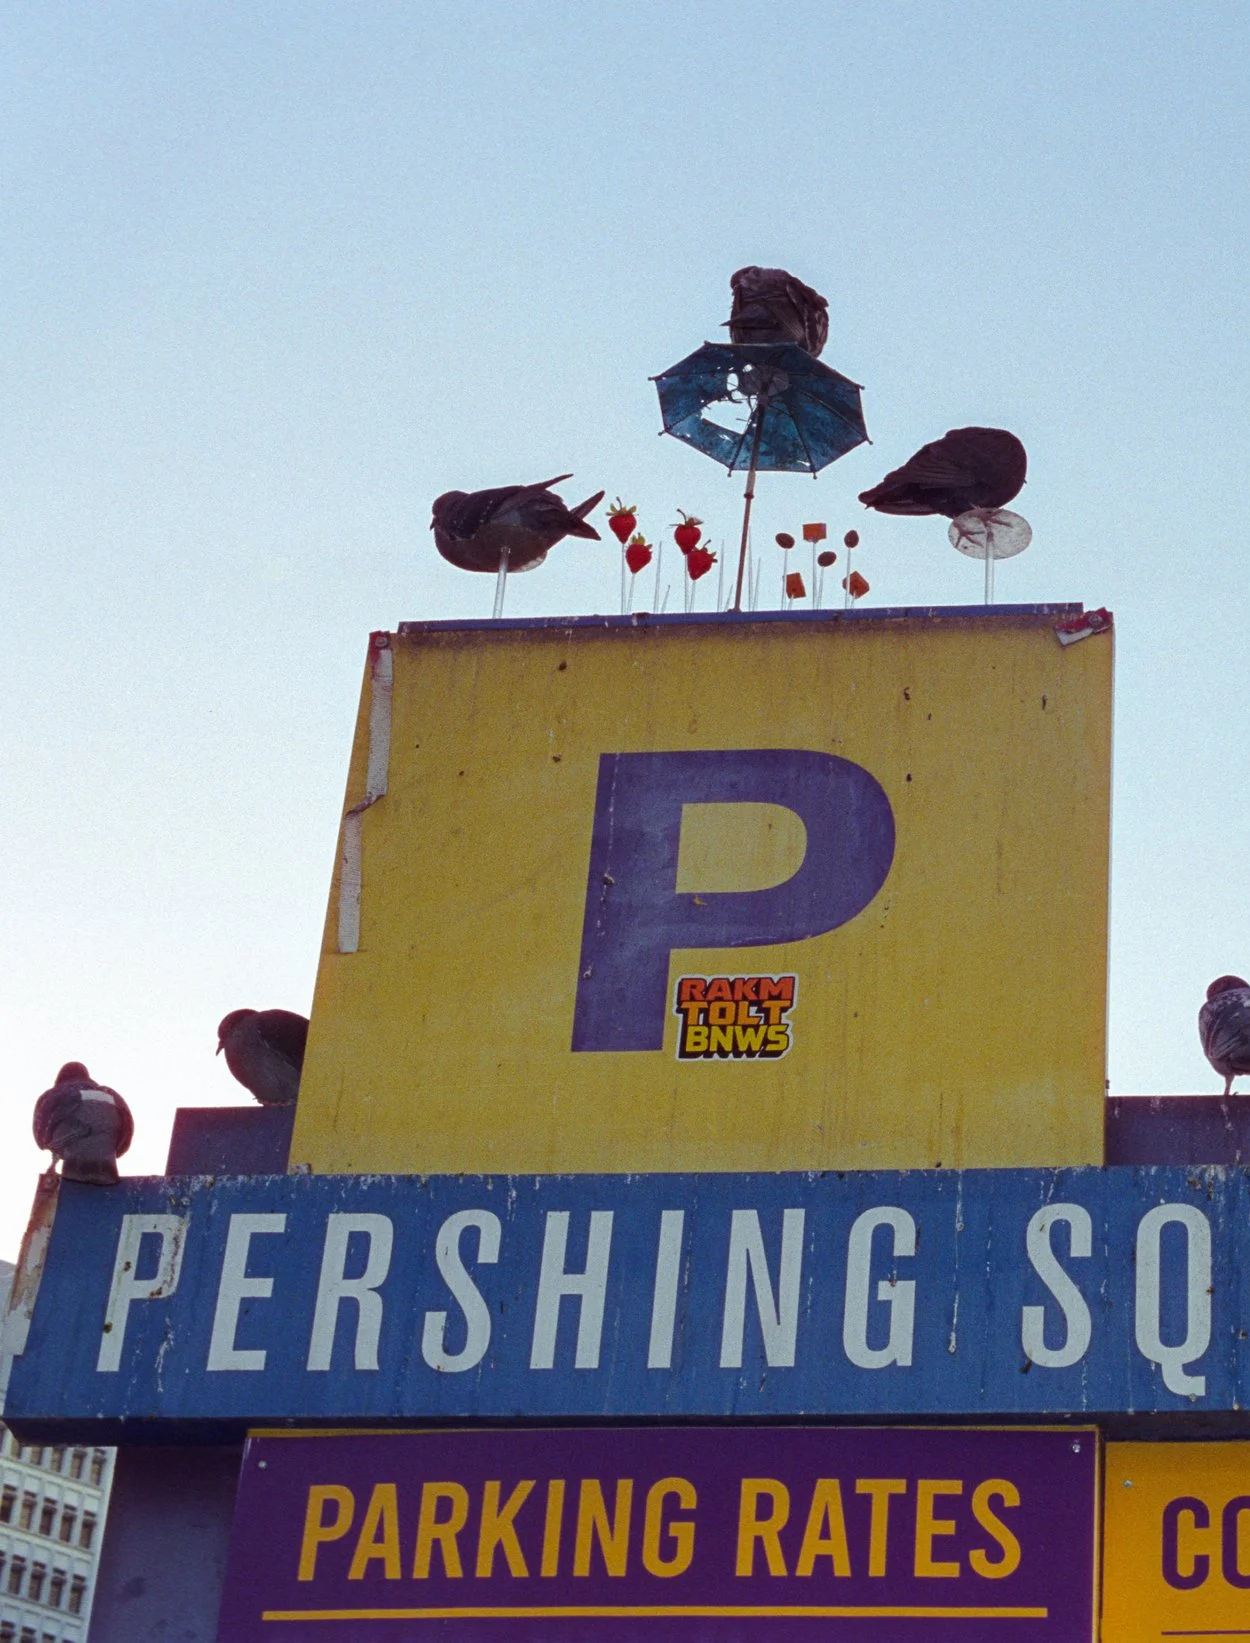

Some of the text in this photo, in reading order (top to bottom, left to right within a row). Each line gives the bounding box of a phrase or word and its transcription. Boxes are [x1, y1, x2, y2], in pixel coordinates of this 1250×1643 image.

[571, 748, 896, 1052] P
[680, 977, 795, 1001] RAKM
[680, 1000, 791, 1025] TOLT
[685, 1024, 789, 1052] BNWS
[96, 1204, 918, 1372] PERSHING
[297, 1477, 1021, 1583] PARKING RATES
